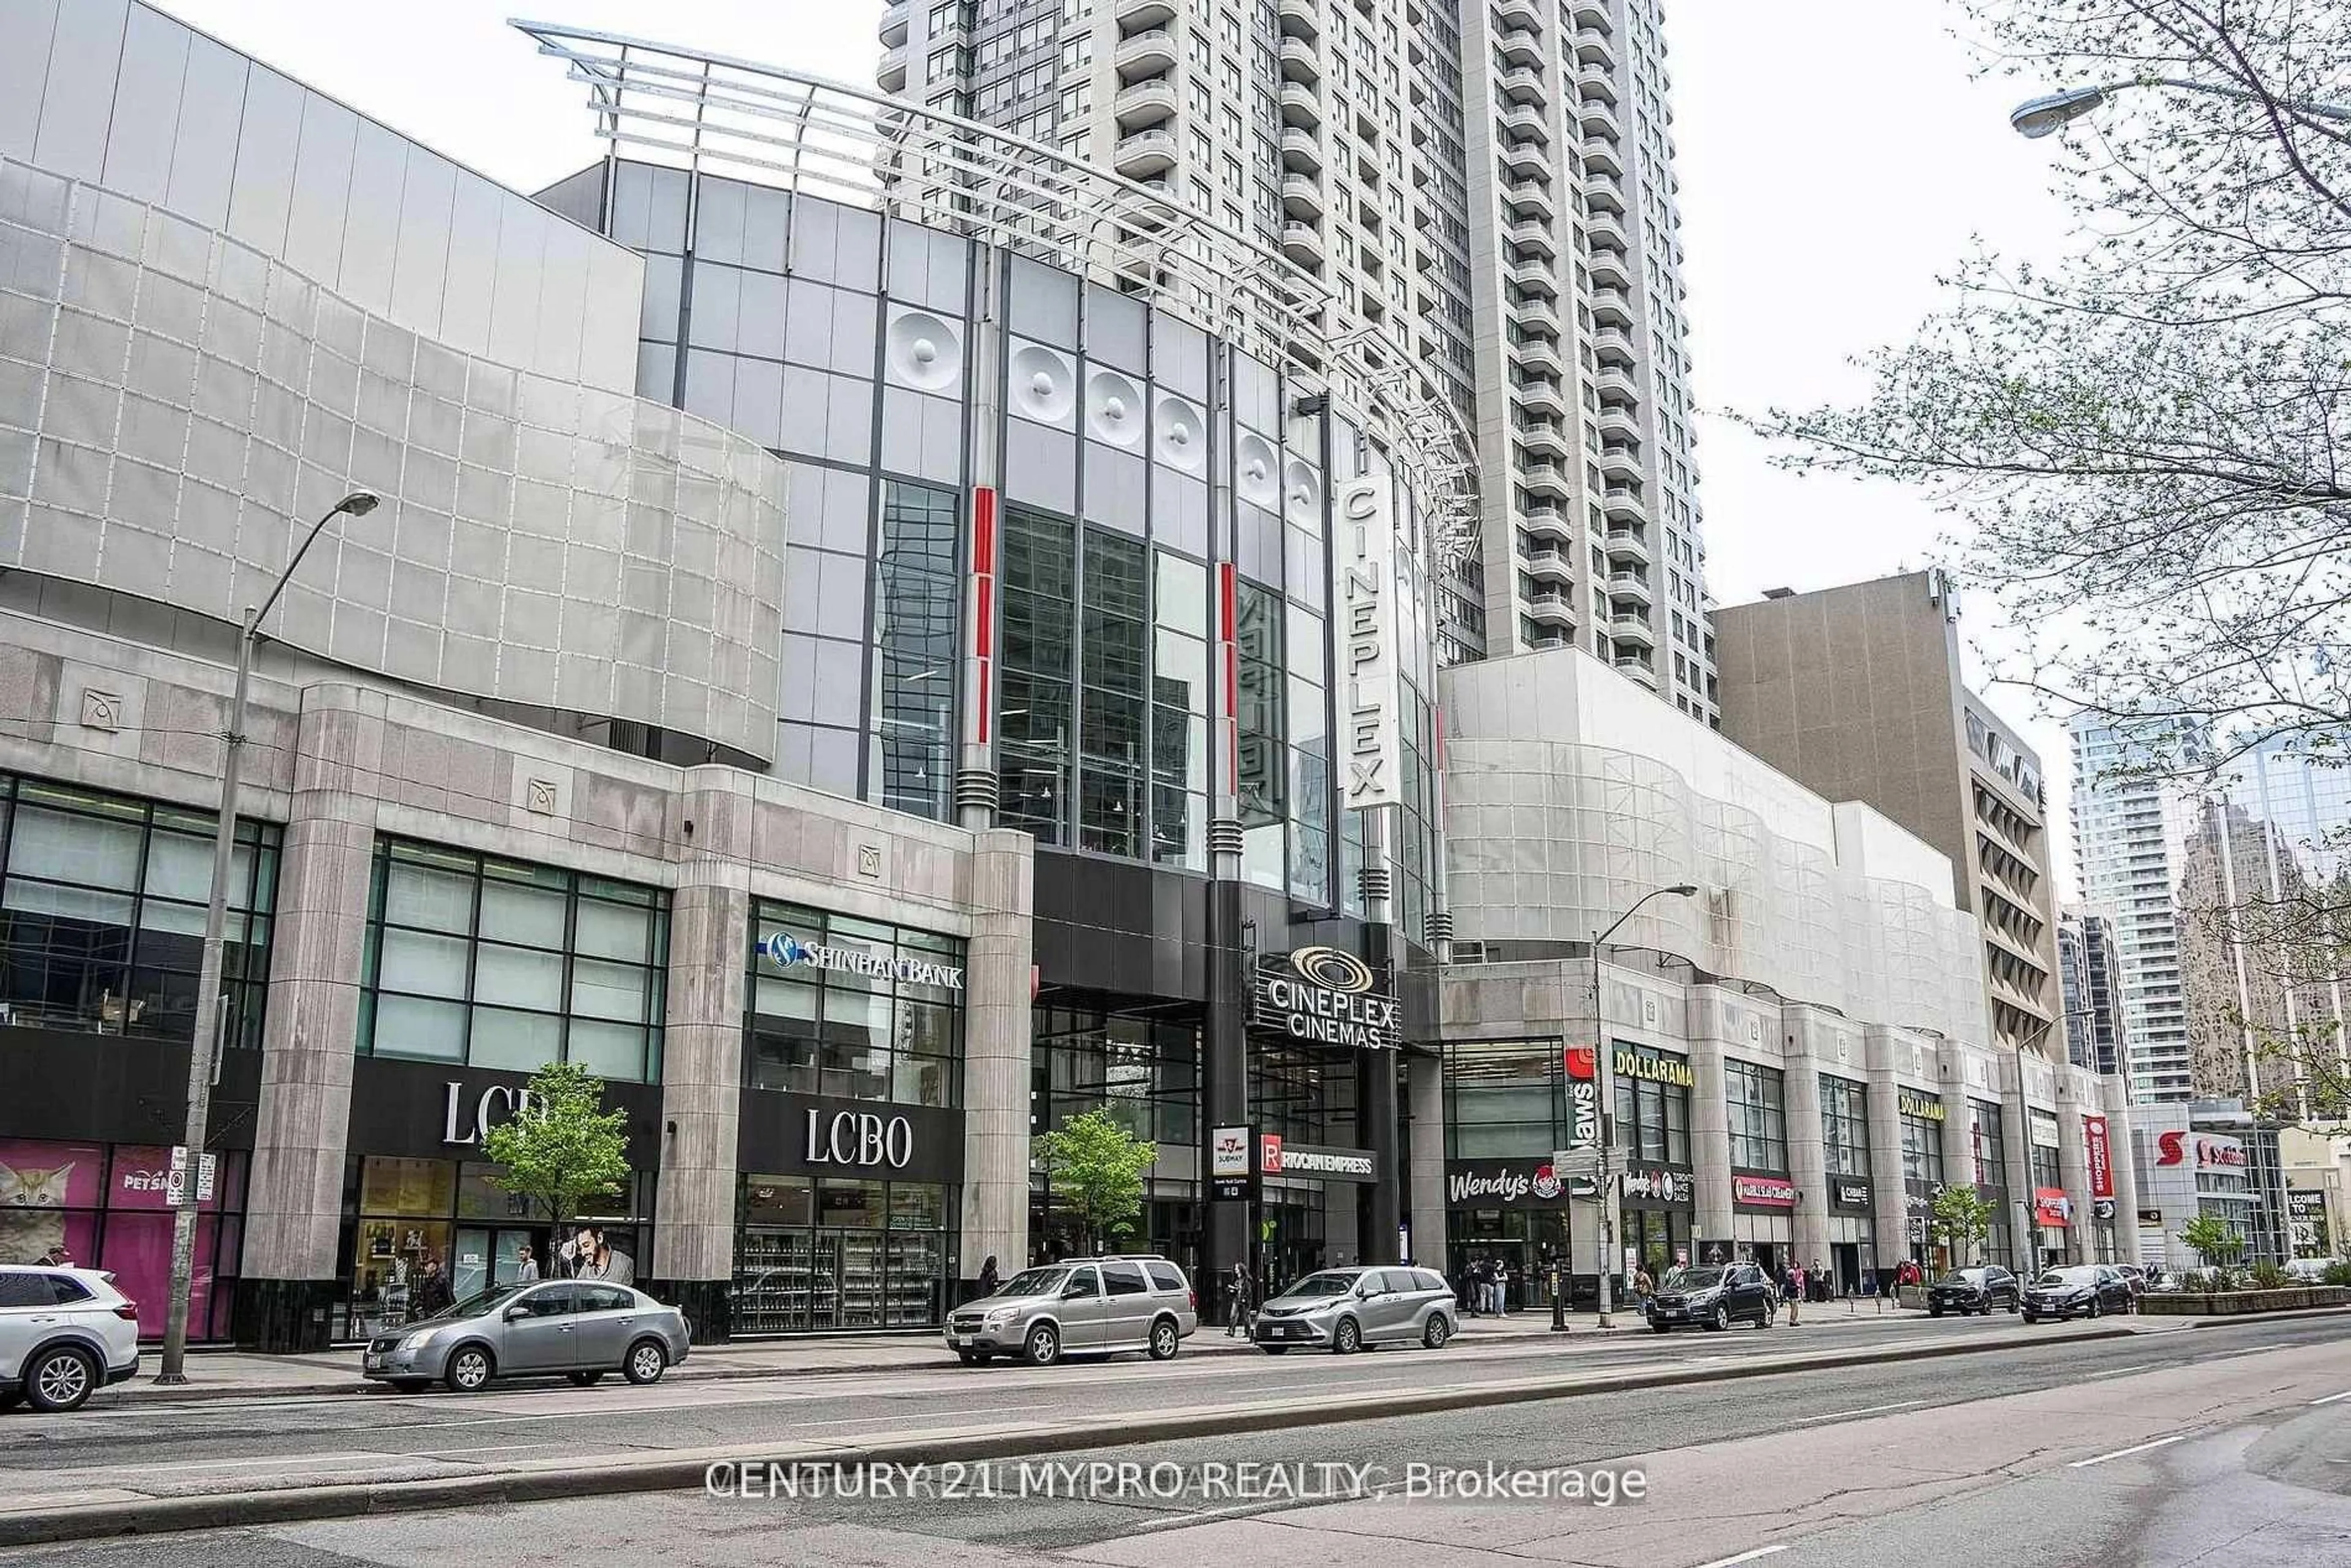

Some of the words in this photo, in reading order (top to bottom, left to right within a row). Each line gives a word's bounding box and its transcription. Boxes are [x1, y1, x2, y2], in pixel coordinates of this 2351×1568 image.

[1344, 487, 1385, 796] CINEPLEX
[804, 942, 907, 978] SHINHAN
[910, 959, 964, 989] BANK
[1268, 980, 1395, 1029] CINEPLEX
[1288, 1013, 1381, 1049] CINEMAS
[1616, 1051, 1693, 1087] DOLLARAMA
[806, 1109, 912, 1168] LCBO
[1570, 1082, 1597, 1195] Llaws
[1281, 1151, 1324, 1170] RIOCAN
[1325, 1155, 1372, 1174] EMPRESS
[1450, 1168, 1529, 1202] Wendy's
[2288, 1195, 2321, 1204] LCOME
[2292, 1204, 2306, 1213] TO
